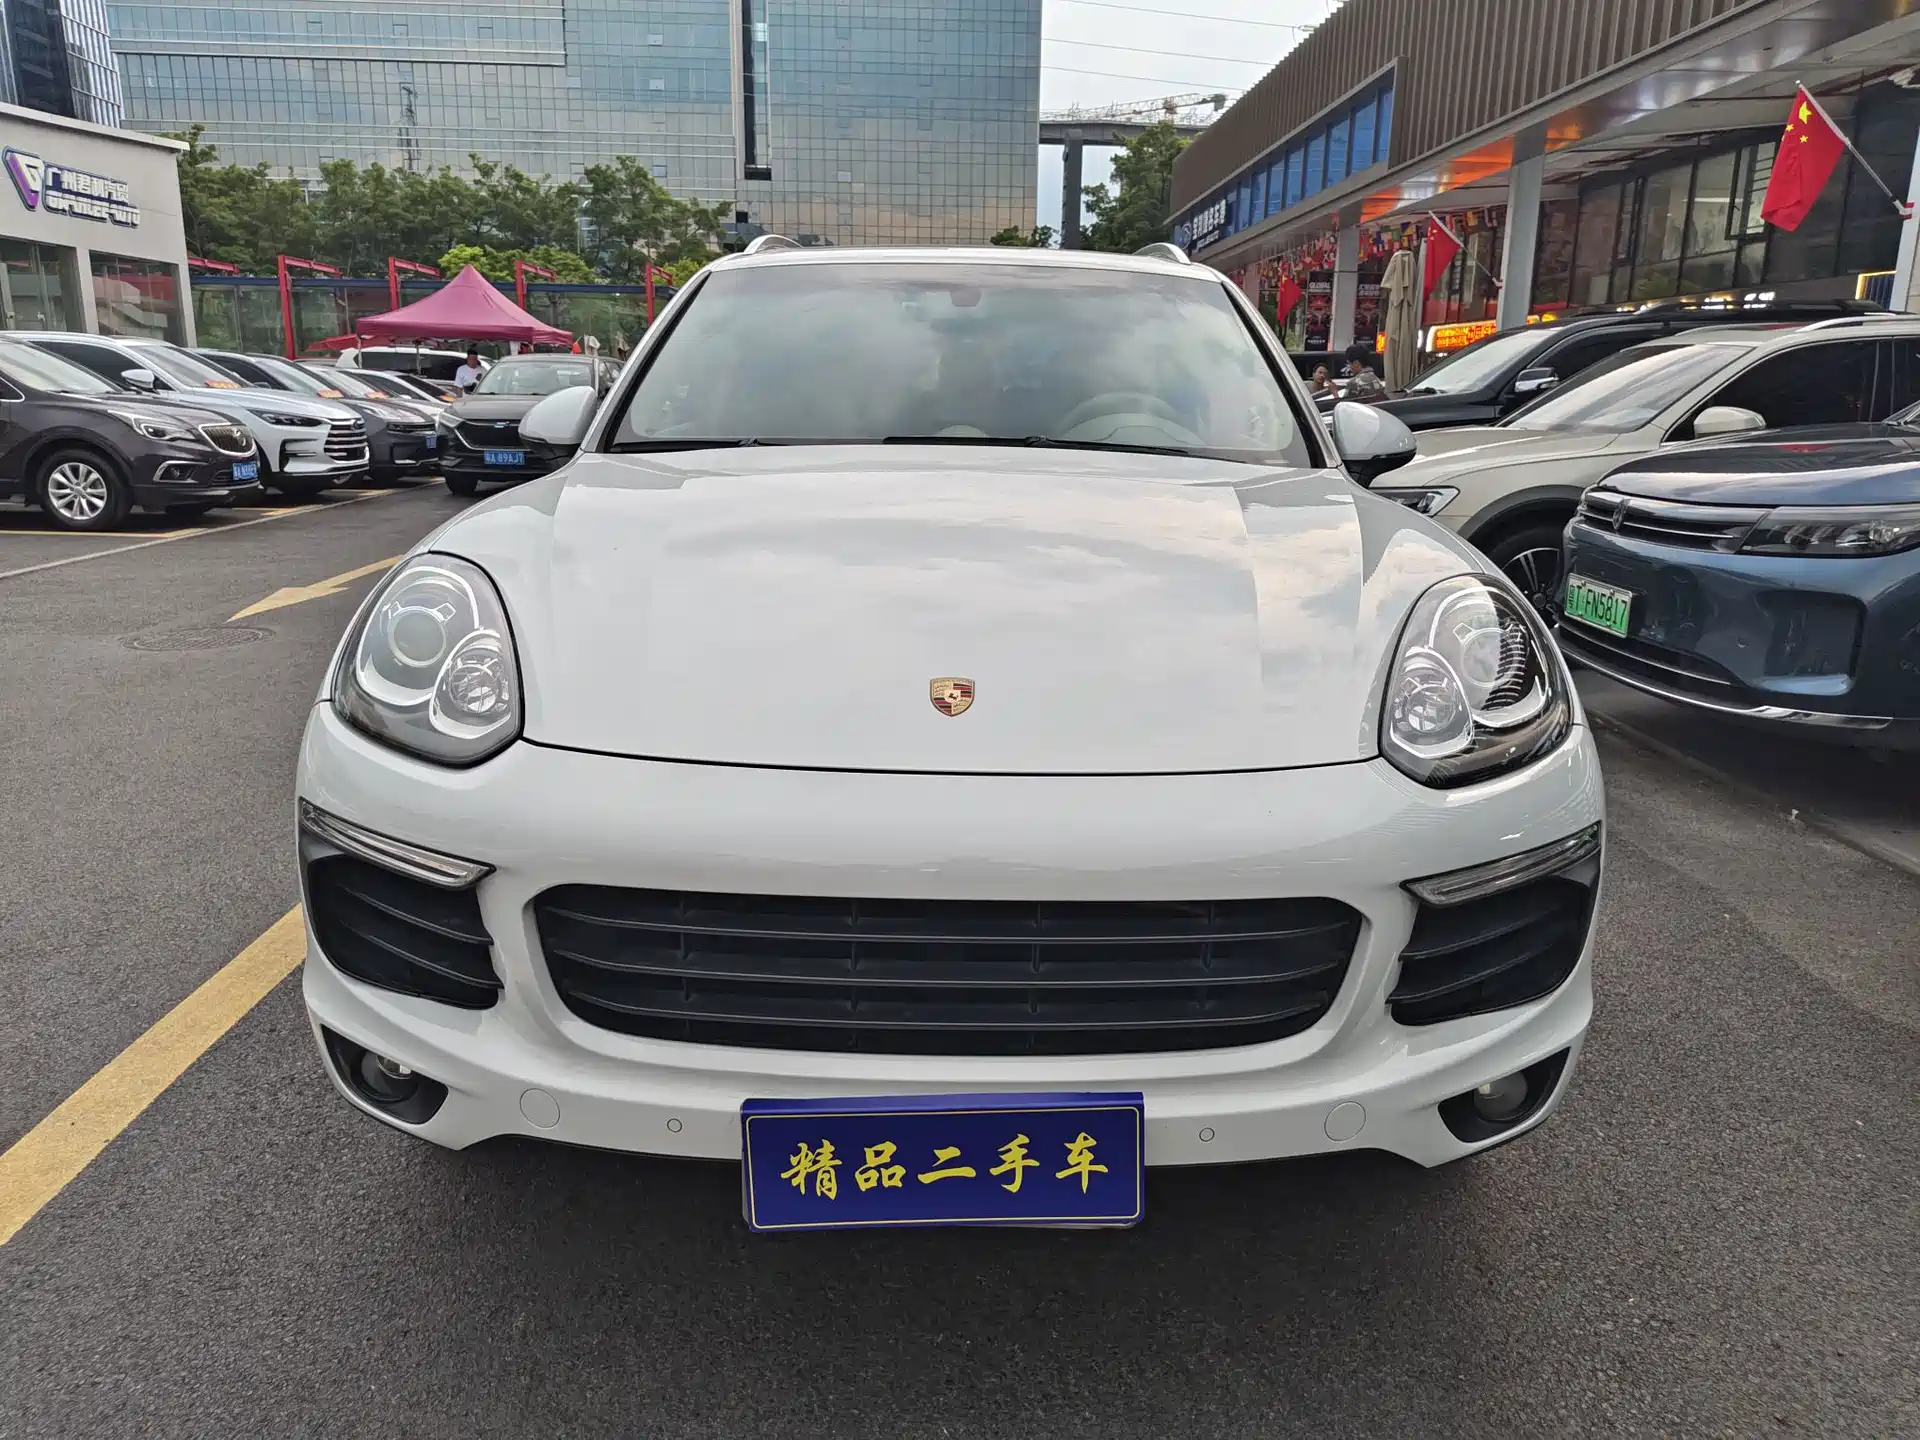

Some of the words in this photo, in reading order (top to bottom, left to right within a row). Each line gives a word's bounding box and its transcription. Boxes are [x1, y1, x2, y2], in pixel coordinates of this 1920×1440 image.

[780, 1131, 1109, 1201] 精品二手车
